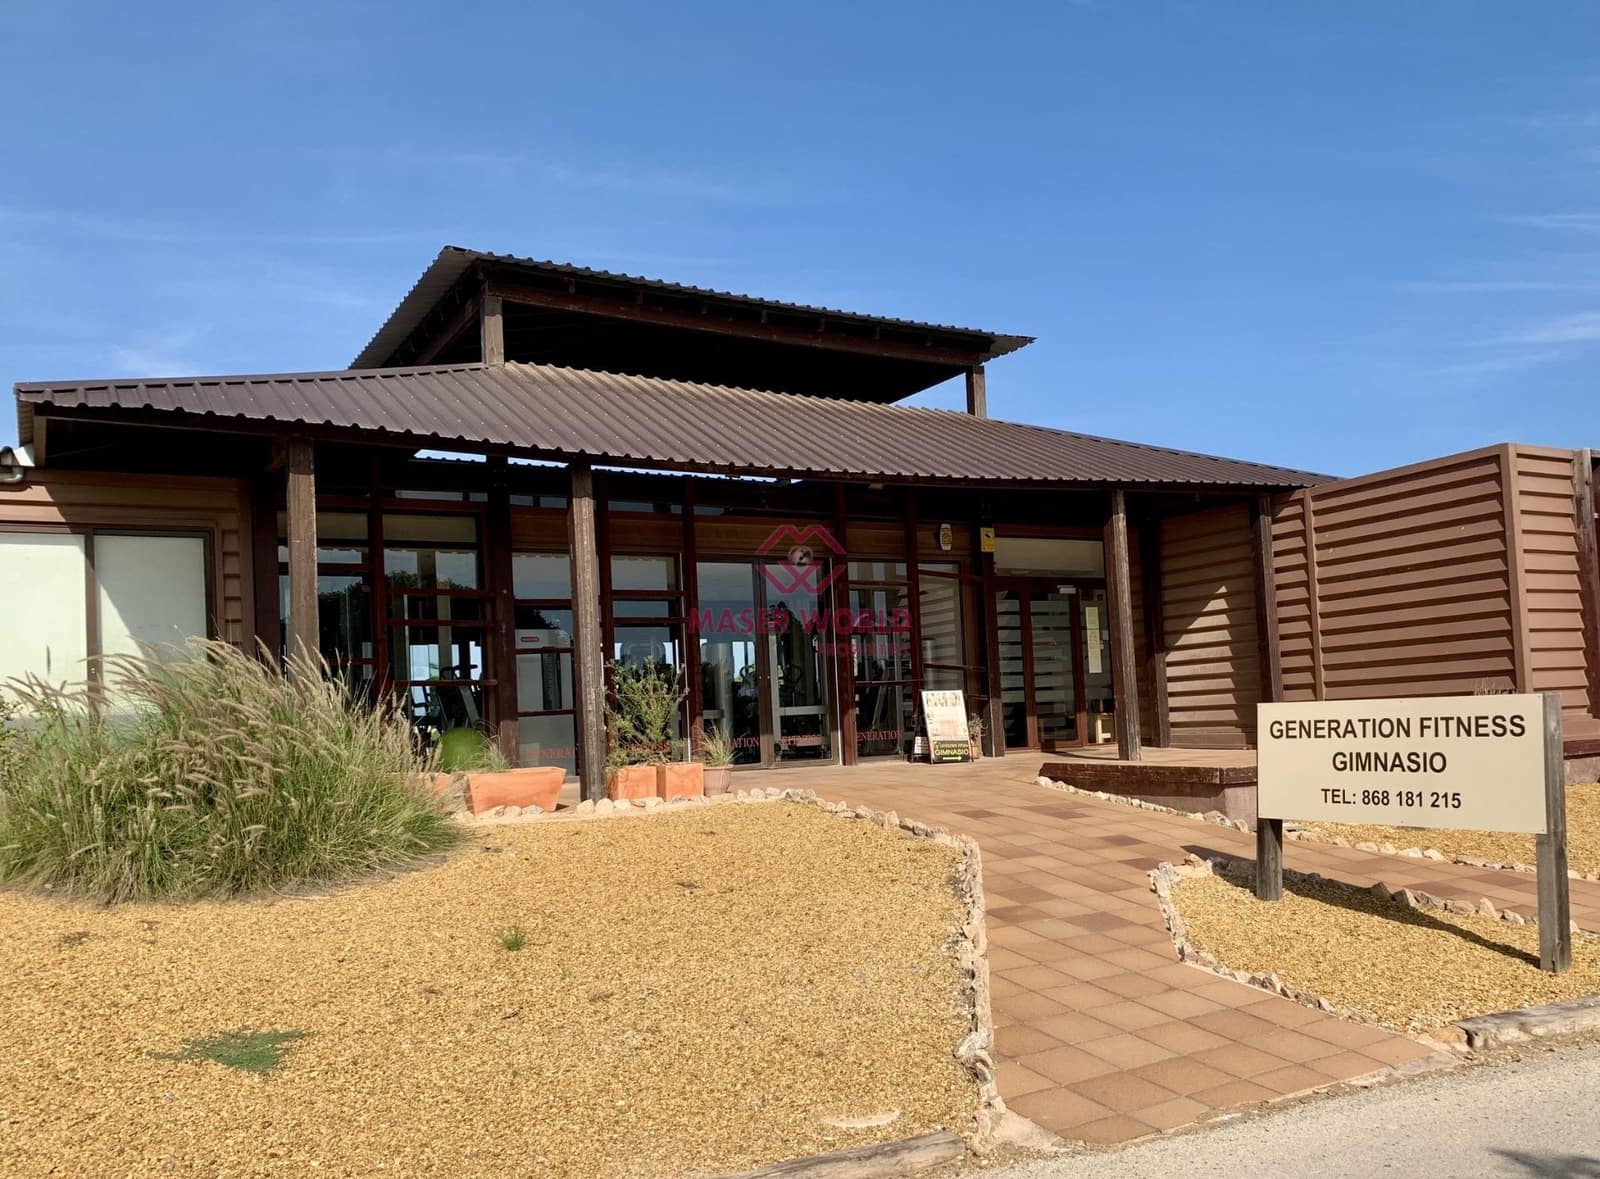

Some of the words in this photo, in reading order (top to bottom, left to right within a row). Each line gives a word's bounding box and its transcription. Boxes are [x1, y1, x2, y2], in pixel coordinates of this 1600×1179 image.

[1269, 717, 1411, 740] GENERATION
[1419, 714, 1526, 738] FITNESS
[1332, 751, 1447, 773] GIMNASIO
[1321, 788, 1357, 805] TEL:
[1362, 789, 1390, 806] 868
[1395, 790, 1423, 808] 181
[1430, 792, 1462, 809] 215
